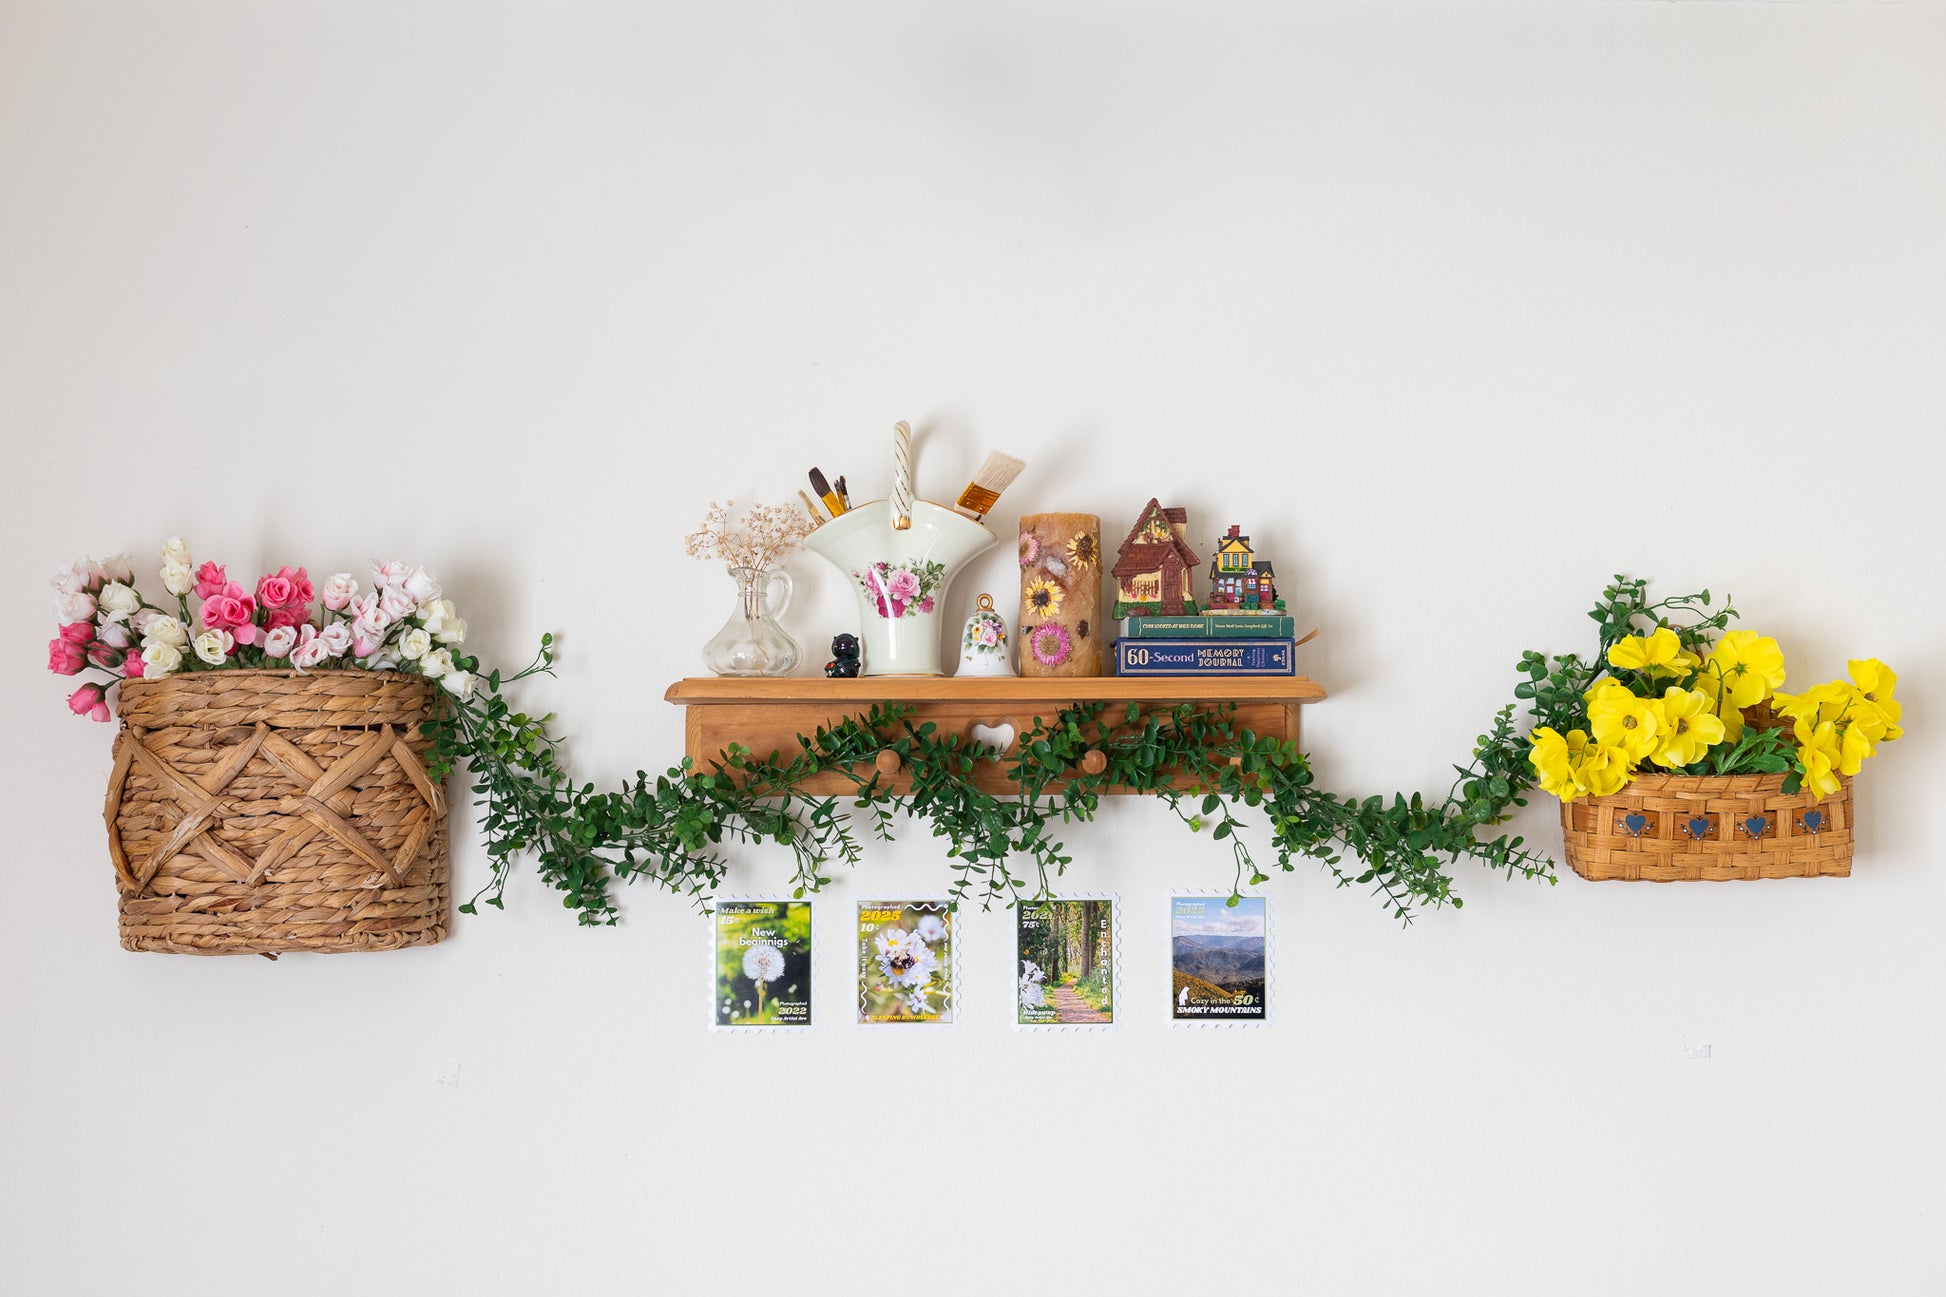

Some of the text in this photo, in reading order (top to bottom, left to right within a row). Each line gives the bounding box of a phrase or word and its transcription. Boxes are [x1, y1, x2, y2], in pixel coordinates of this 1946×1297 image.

[1127, 648, 1194, 665] 60-Second
[1198, 649, 1244, 657] MEMORY
[1198, 658, 1243, 667] JOURNAL
[861, 903, 900, 911] Photographed
[860, 910, 901, 922] 2025
[752, 928, 775, 937] New
[778, 1006, 807, 1015] 2022
[1176, 1006, 1262, 1014] SMOKY MOUNTAINS
